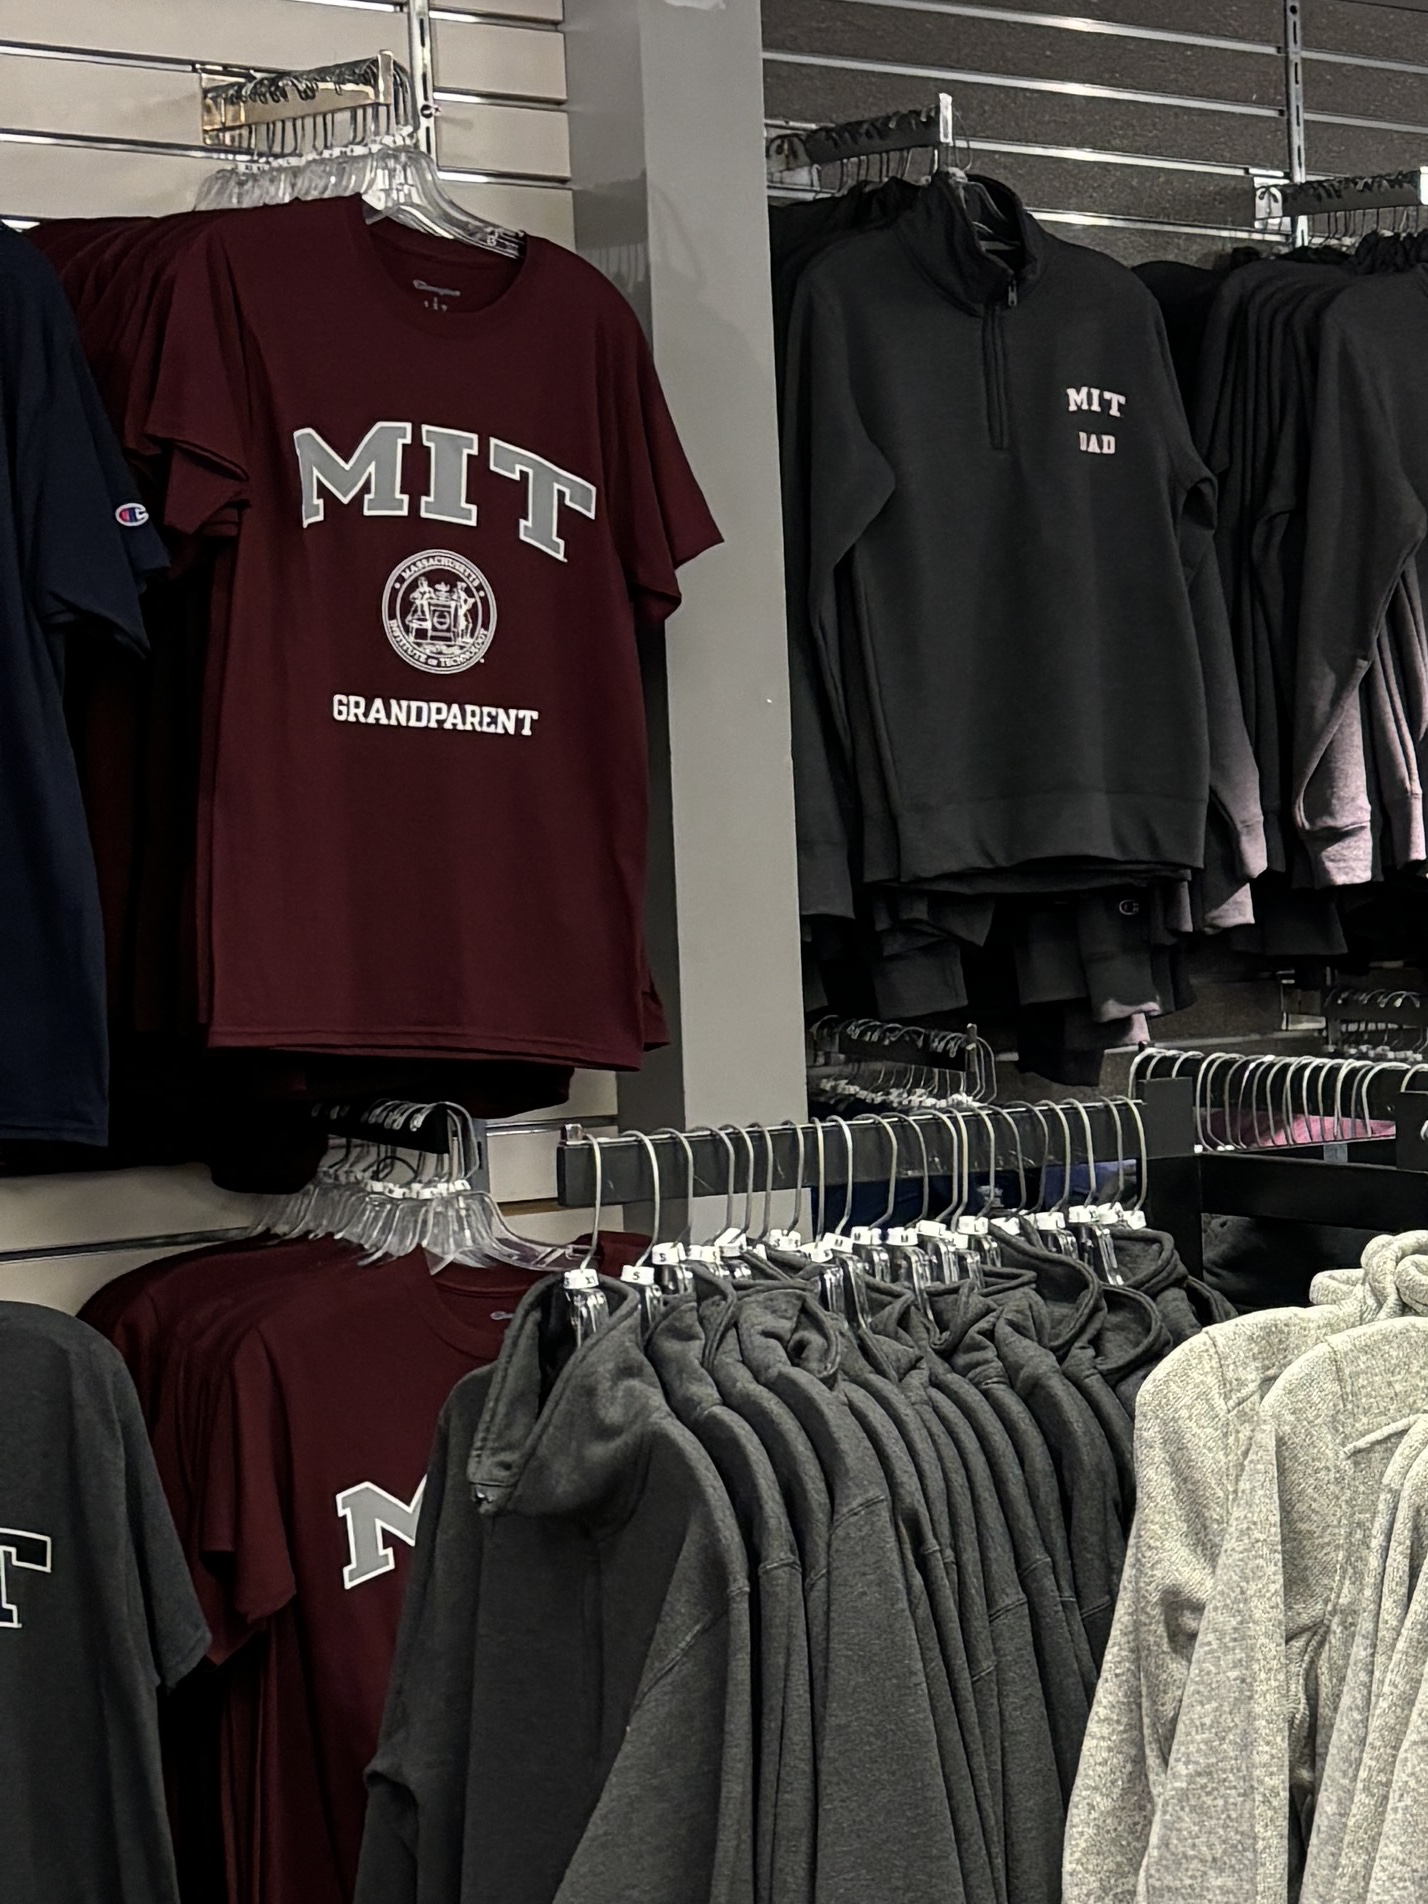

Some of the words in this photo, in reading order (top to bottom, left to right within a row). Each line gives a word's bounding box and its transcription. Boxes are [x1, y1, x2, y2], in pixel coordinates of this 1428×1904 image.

[1066, 386, 1127, 417] MIT
[293, 421, 597, 562] MIT
[401, 556, 481, 587] MASSACHUSETTS
[332, 694, 539, 736] GRANDPARENT
